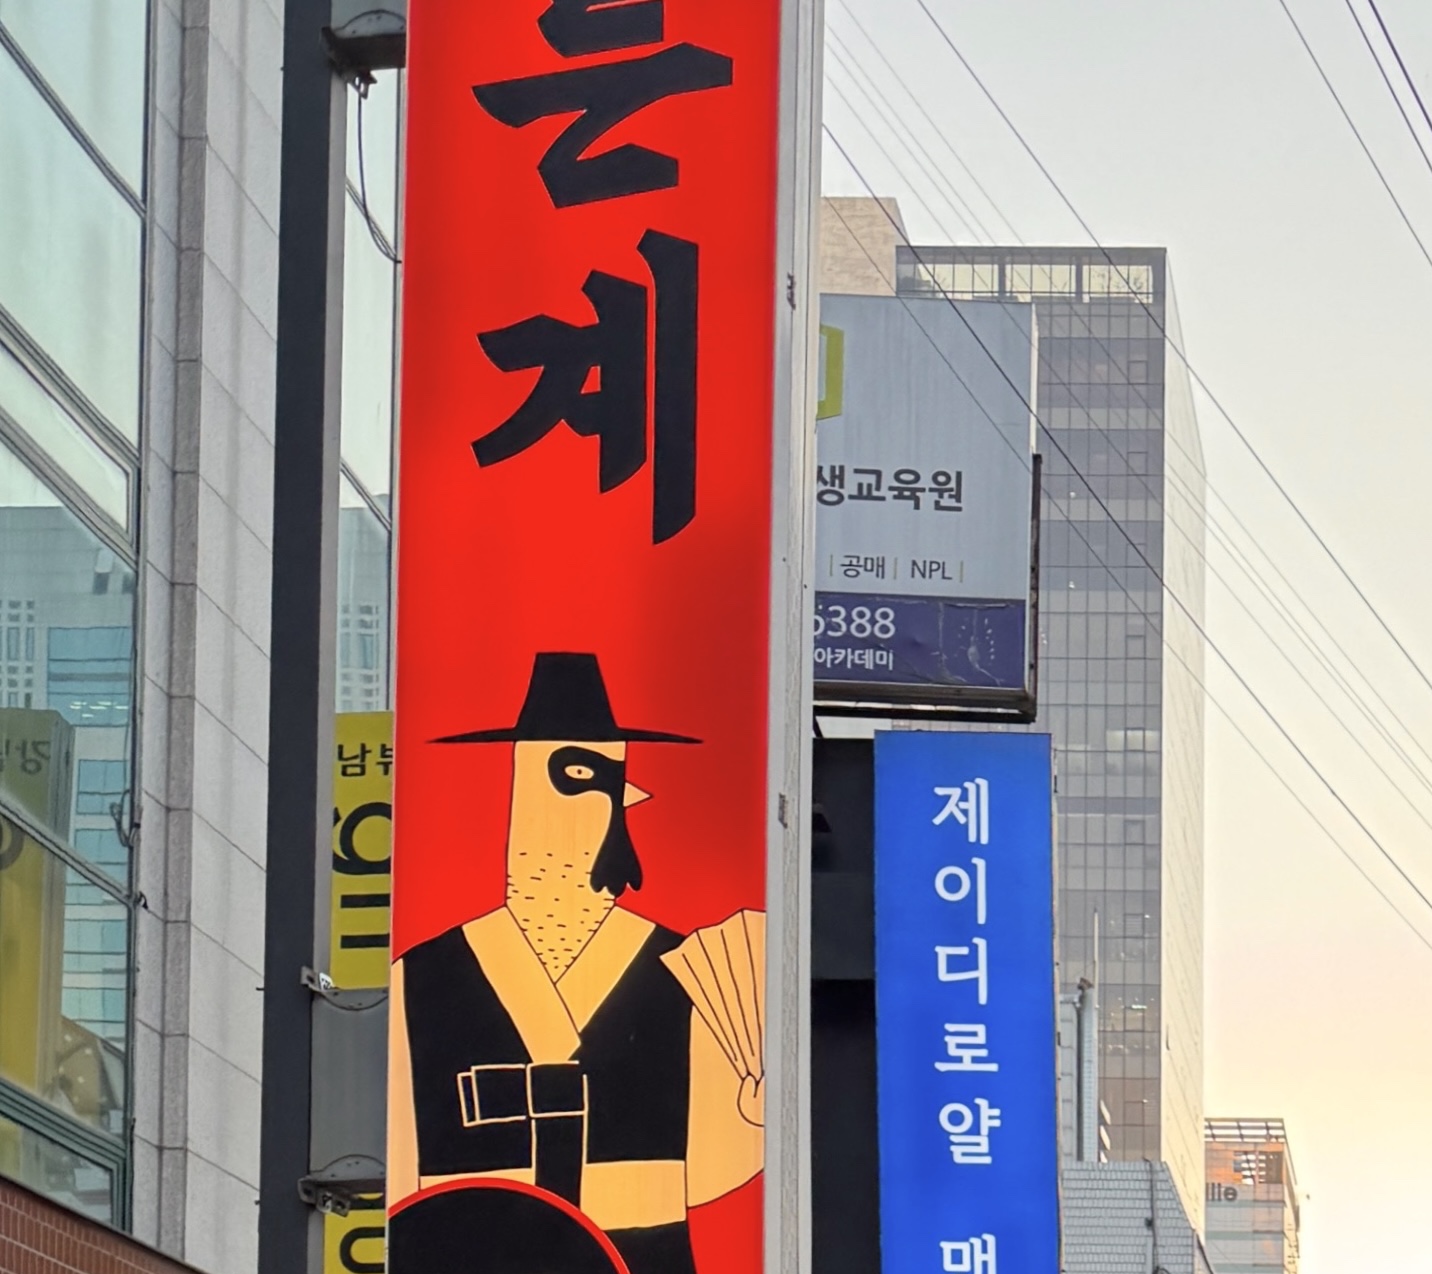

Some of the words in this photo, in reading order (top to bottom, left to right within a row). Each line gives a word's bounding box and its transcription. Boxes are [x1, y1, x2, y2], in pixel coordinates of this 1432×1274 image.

[840, 555, 886, 580] 공매
[911, 558, 953, 581] NPL
[931, 777, 1002, 1166] 제이디로얄
